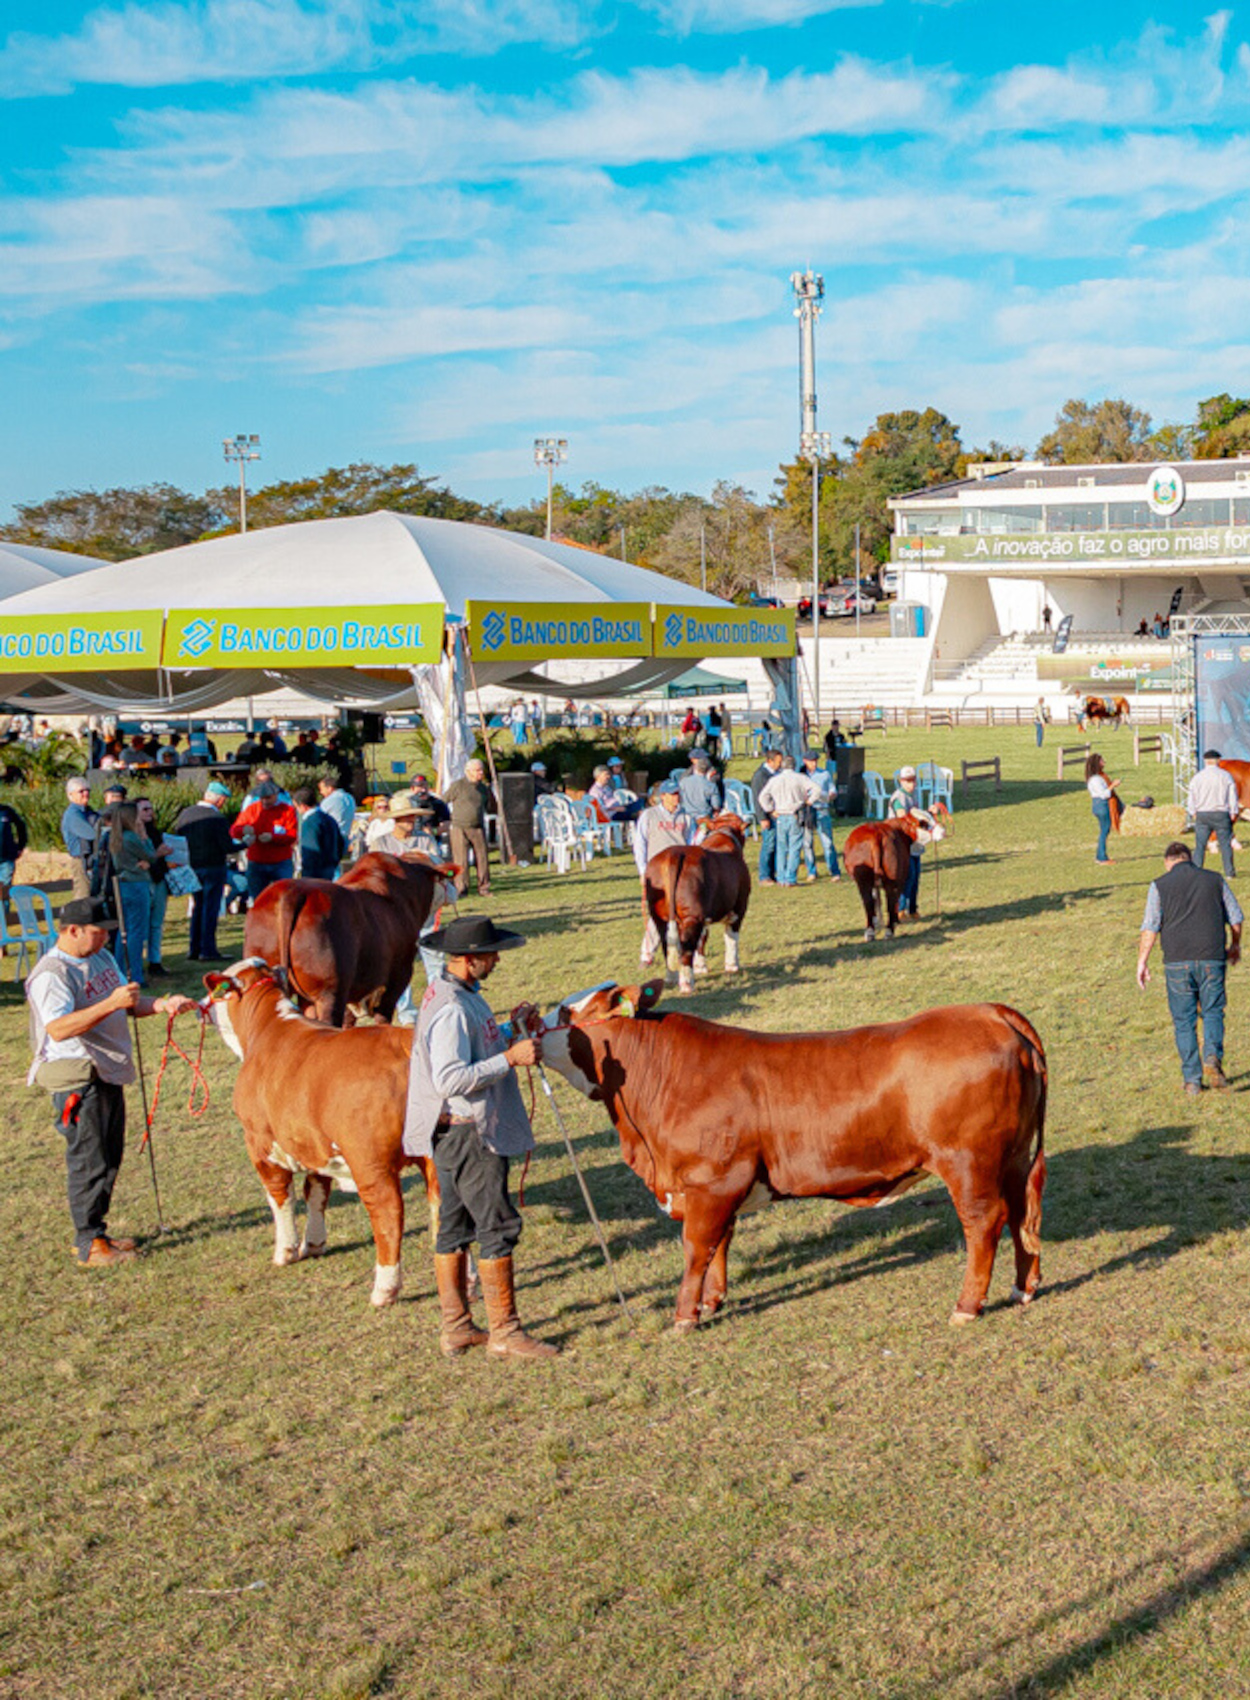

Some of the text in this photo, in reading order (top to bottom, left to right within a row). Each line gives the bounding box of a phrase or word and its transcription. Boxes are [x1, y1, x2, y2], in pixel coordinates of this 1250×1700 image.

[992, 538, 1074, 558] inovação
[1079, 536, 1104, 553] faz
[1110, 540, 1122, 553] o
[1128, 537, 1169, 556] agro
[1175, 533, 1219, 551] mais
[0, 628, 145, 658] CO DO BRASIL
[219, 621, 425, 653] BANCO DO BRASIL
[509, 616, 643, 645] BANCO DO BRASIL
[686, 618, 788, 643] BANCO DO BRASIL
